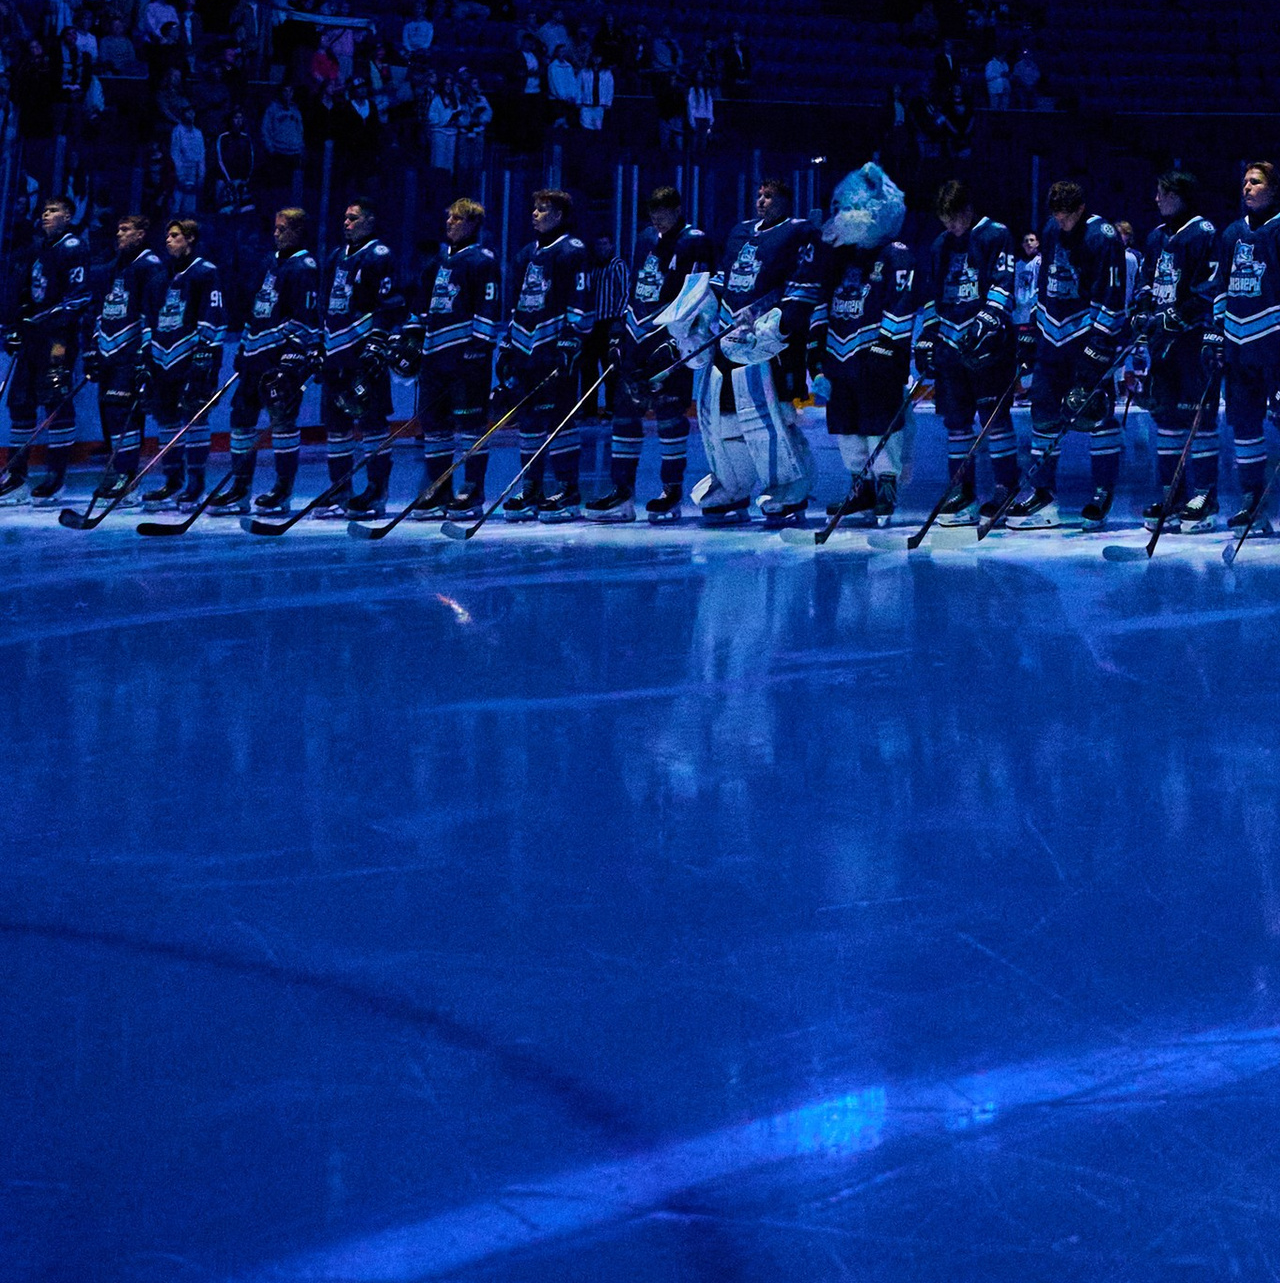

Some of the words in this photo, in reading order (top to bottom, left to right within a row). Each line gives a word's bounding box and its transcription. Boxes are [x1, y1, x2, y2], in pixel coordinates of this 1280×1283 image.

[210, 289, 224, 309] 91
[977, 310, 998, 326] UER
[1203, 333, 1225, 343] UER
